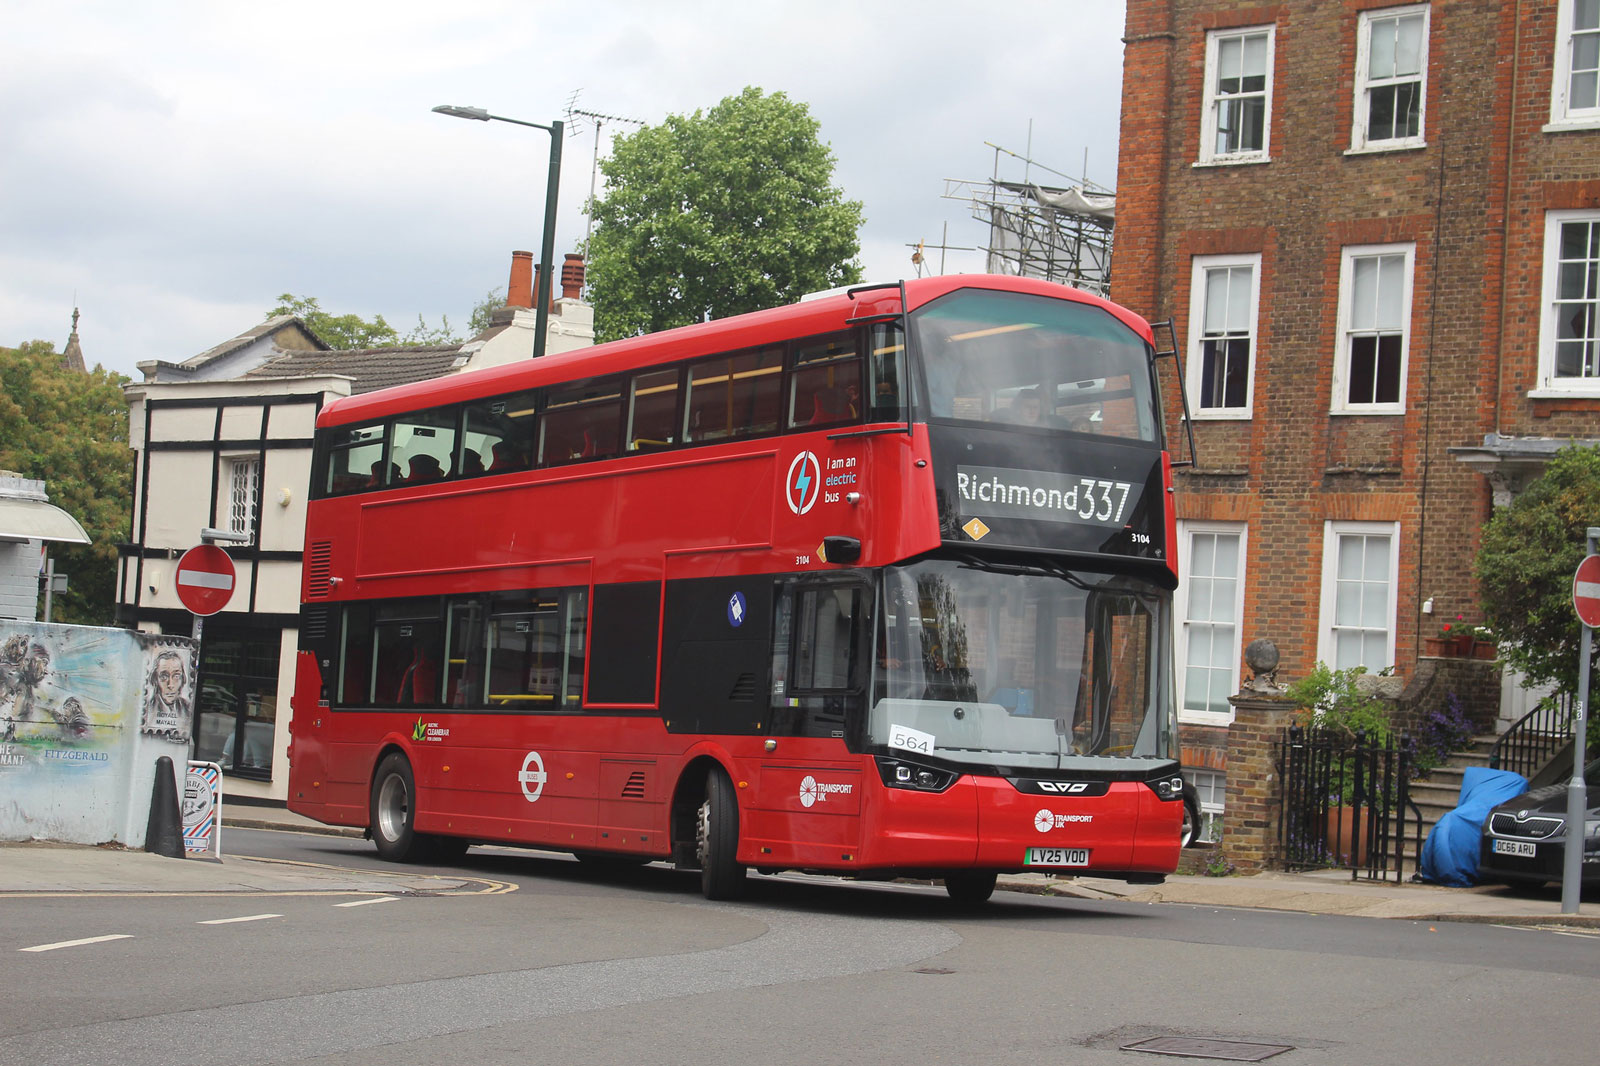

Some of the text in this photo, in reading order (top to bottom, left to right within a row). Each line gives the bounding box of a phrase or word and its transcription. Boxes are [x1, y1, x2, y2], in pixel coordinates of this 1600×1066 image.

[826, 457, 856, 470] I am an
[825, 472, 857, 486] electric
[824, 491, 840, 503] bus
[957, 472, 1132, 523] Richmond 337
[1131, 533, 1151, 545] 3104
[795, 555, 810, 566] 3104
[894, 733, 929, 753] 564
[0, 744, 12, 755] HE
[45, 749, 109, 761] FITZGERALD
[0, 754, 25, 766] NANT
[186, 780, 206, 794] RBER
[817, 783, 853, 794] TRANSPORT
[817, 792, 827, 802] UK
[1054, 814, 1094, 823] TRANSPORT
[184, 839, 194, 847] EN
[1496, 842, 1535, 855] DC66 ARU
[1031, 849, 1086, 863] LV25 VOO
